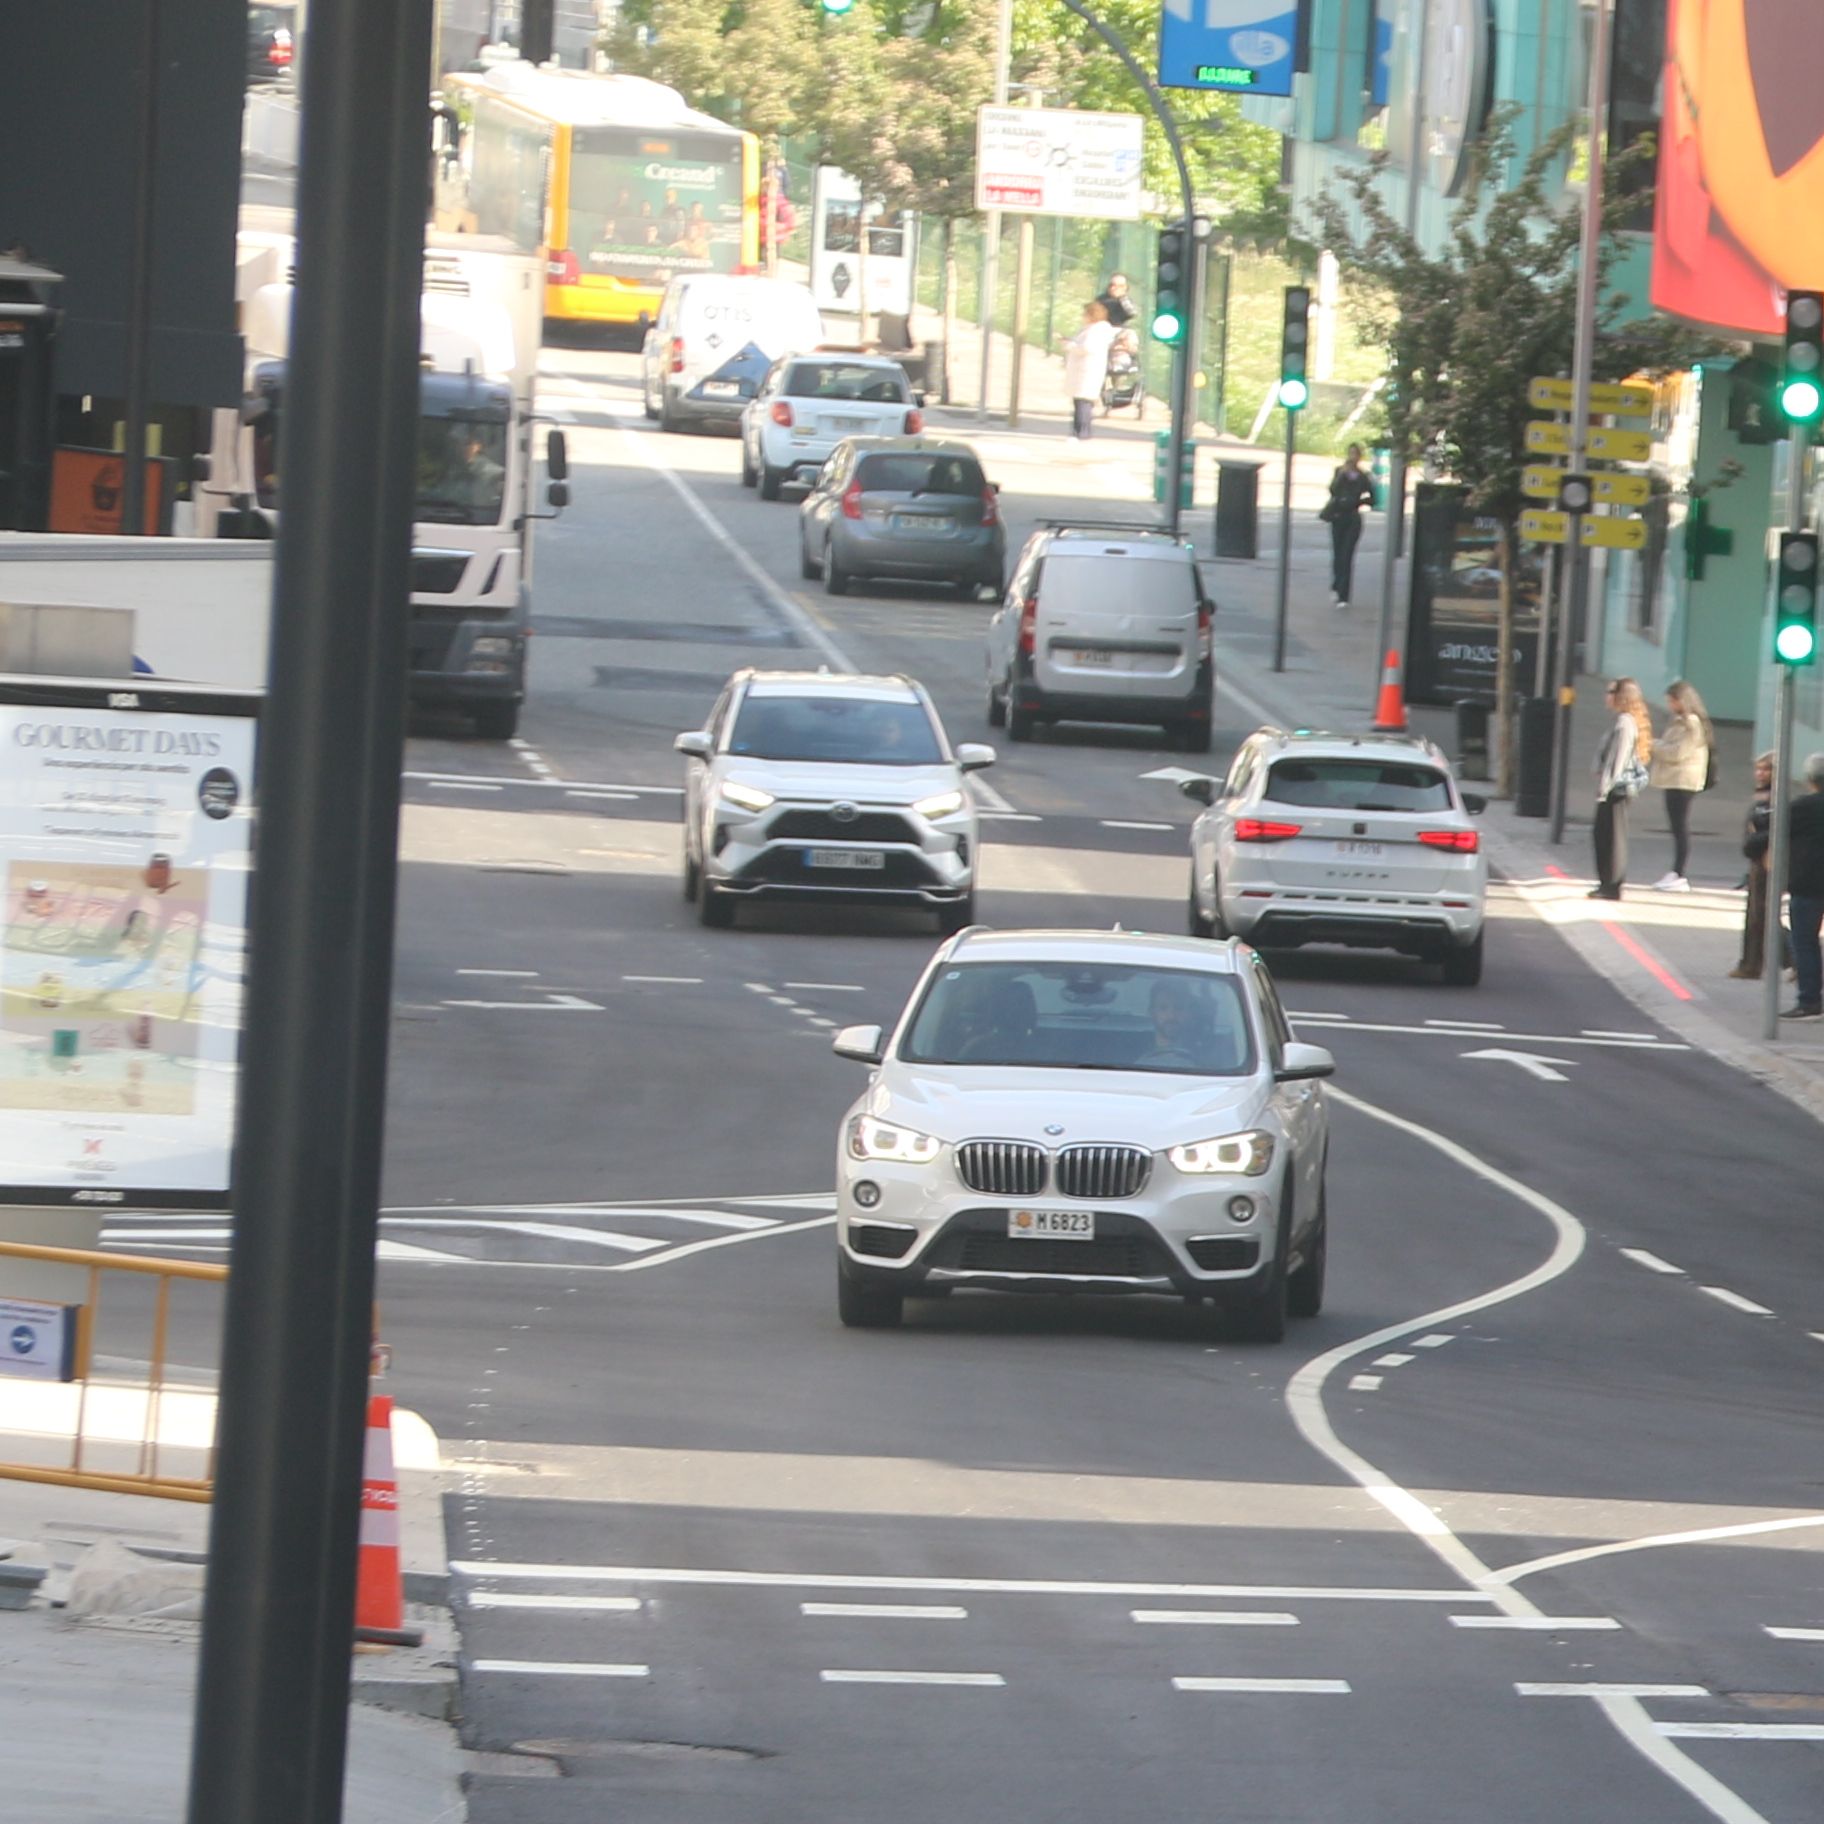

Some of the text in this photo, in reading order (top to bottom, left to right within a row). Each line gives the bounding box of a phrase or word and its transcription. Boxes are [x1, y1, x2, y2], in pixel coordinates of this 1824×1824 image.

[704, 305, 752, 322] OTIS
[1438, 643, 1522, 663] angeo
[14, 723, 221, 756] GOURMET DAYS
